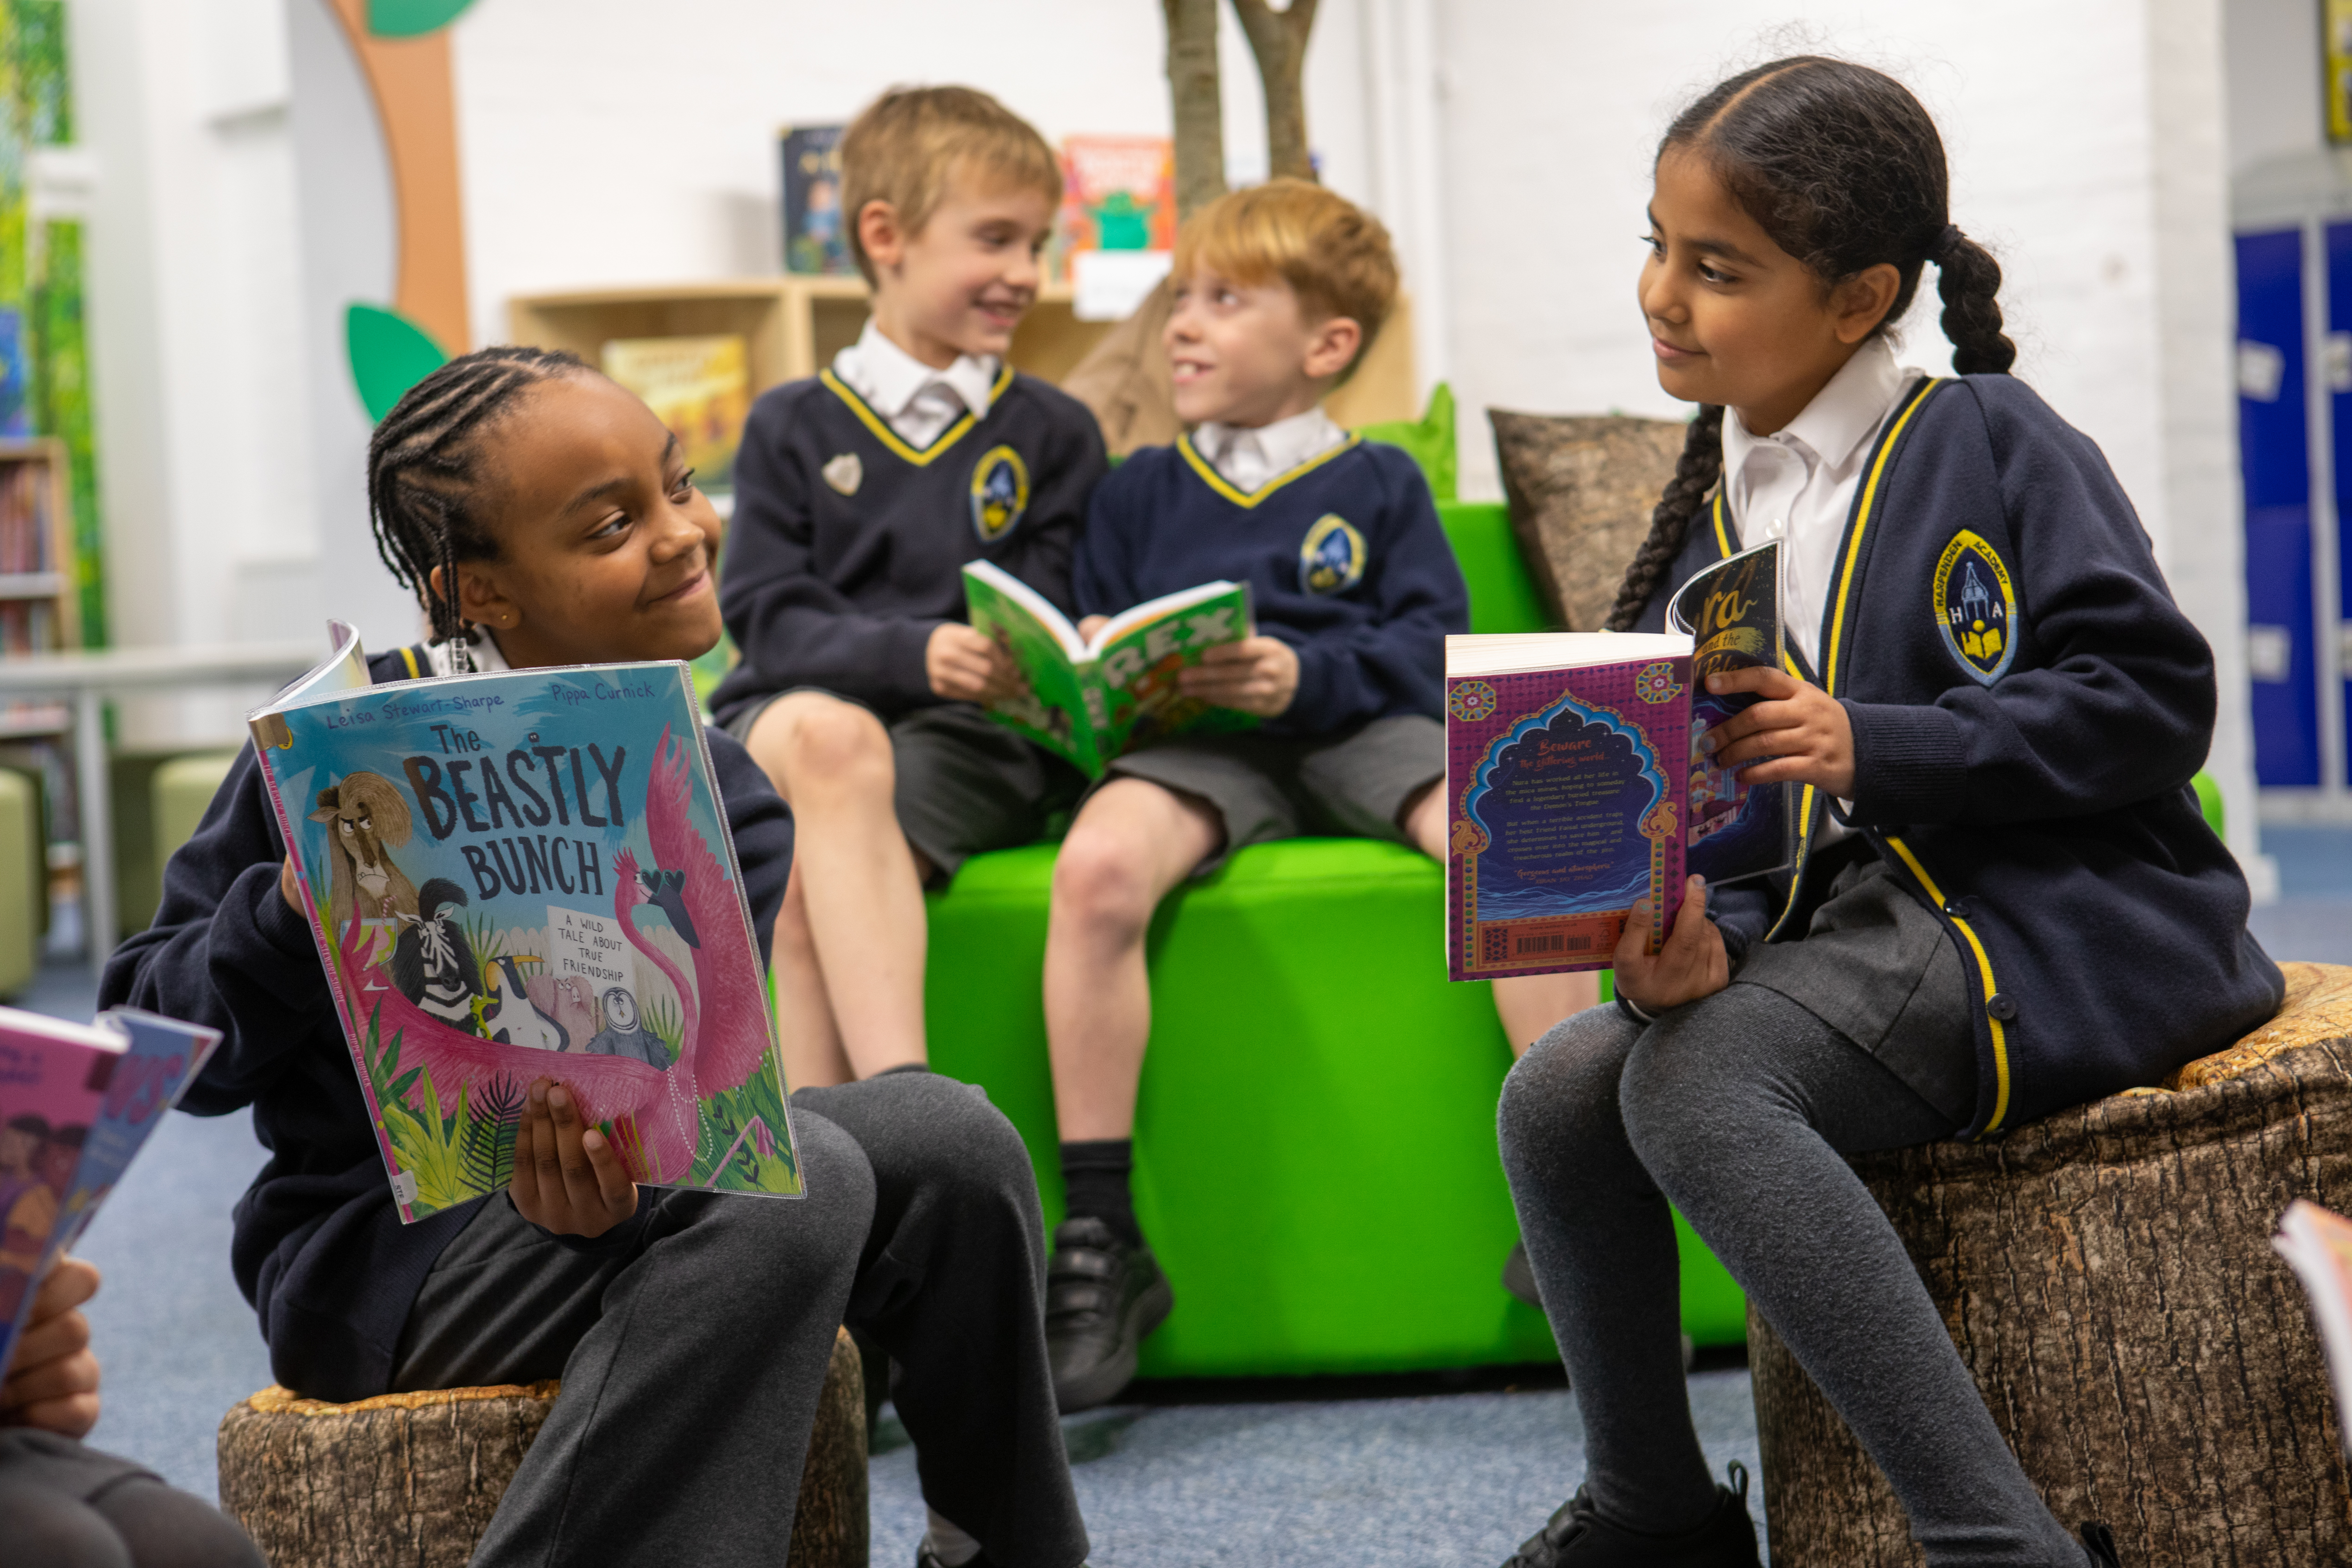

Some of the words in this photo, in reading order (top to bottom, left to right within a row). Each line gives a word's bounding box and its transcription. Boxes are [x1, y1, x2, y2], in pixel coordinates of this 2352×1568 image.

[1936, 540, 1963, 607] HARPENDEN
[1973, 541, 2008, 585] ACADEMY
[1949, 606, 1963, 625] H
[1992, 601, 2004, 618] A
[1102, 606, 1236, 690] REX
[1722, 632, 1741, 647] the
[551, 684, 590, 706] Pippa
[595, 681, 655, 700] Curnick
[327, 708, 376, 729] Leisa
[382, 695, 504, 719] Stewart-Sharpe
[430, 724, 482, 754] The
[1537, 739, 1591, 756] Beware
[1519, 759, 1534, 769] the
[1534, 755, 1578, 771] glittering
[402, 742, 626, 841] BEASTLY
[461, 834, 604, 900] BUNCH
[566, 914, 572, 926] A
[580, 918, 604, 933] WILD
[558, 928, 584, 943] TALE
[593, 936, 622, 952] ABOUT
[578, 947, 603, 962] TRUE
[563, 958, 623, 982] FRIENDSHIP
[348, 1033, 360, 1054] PIPPA
[354, 1055, 372, 1088] CURNICK
